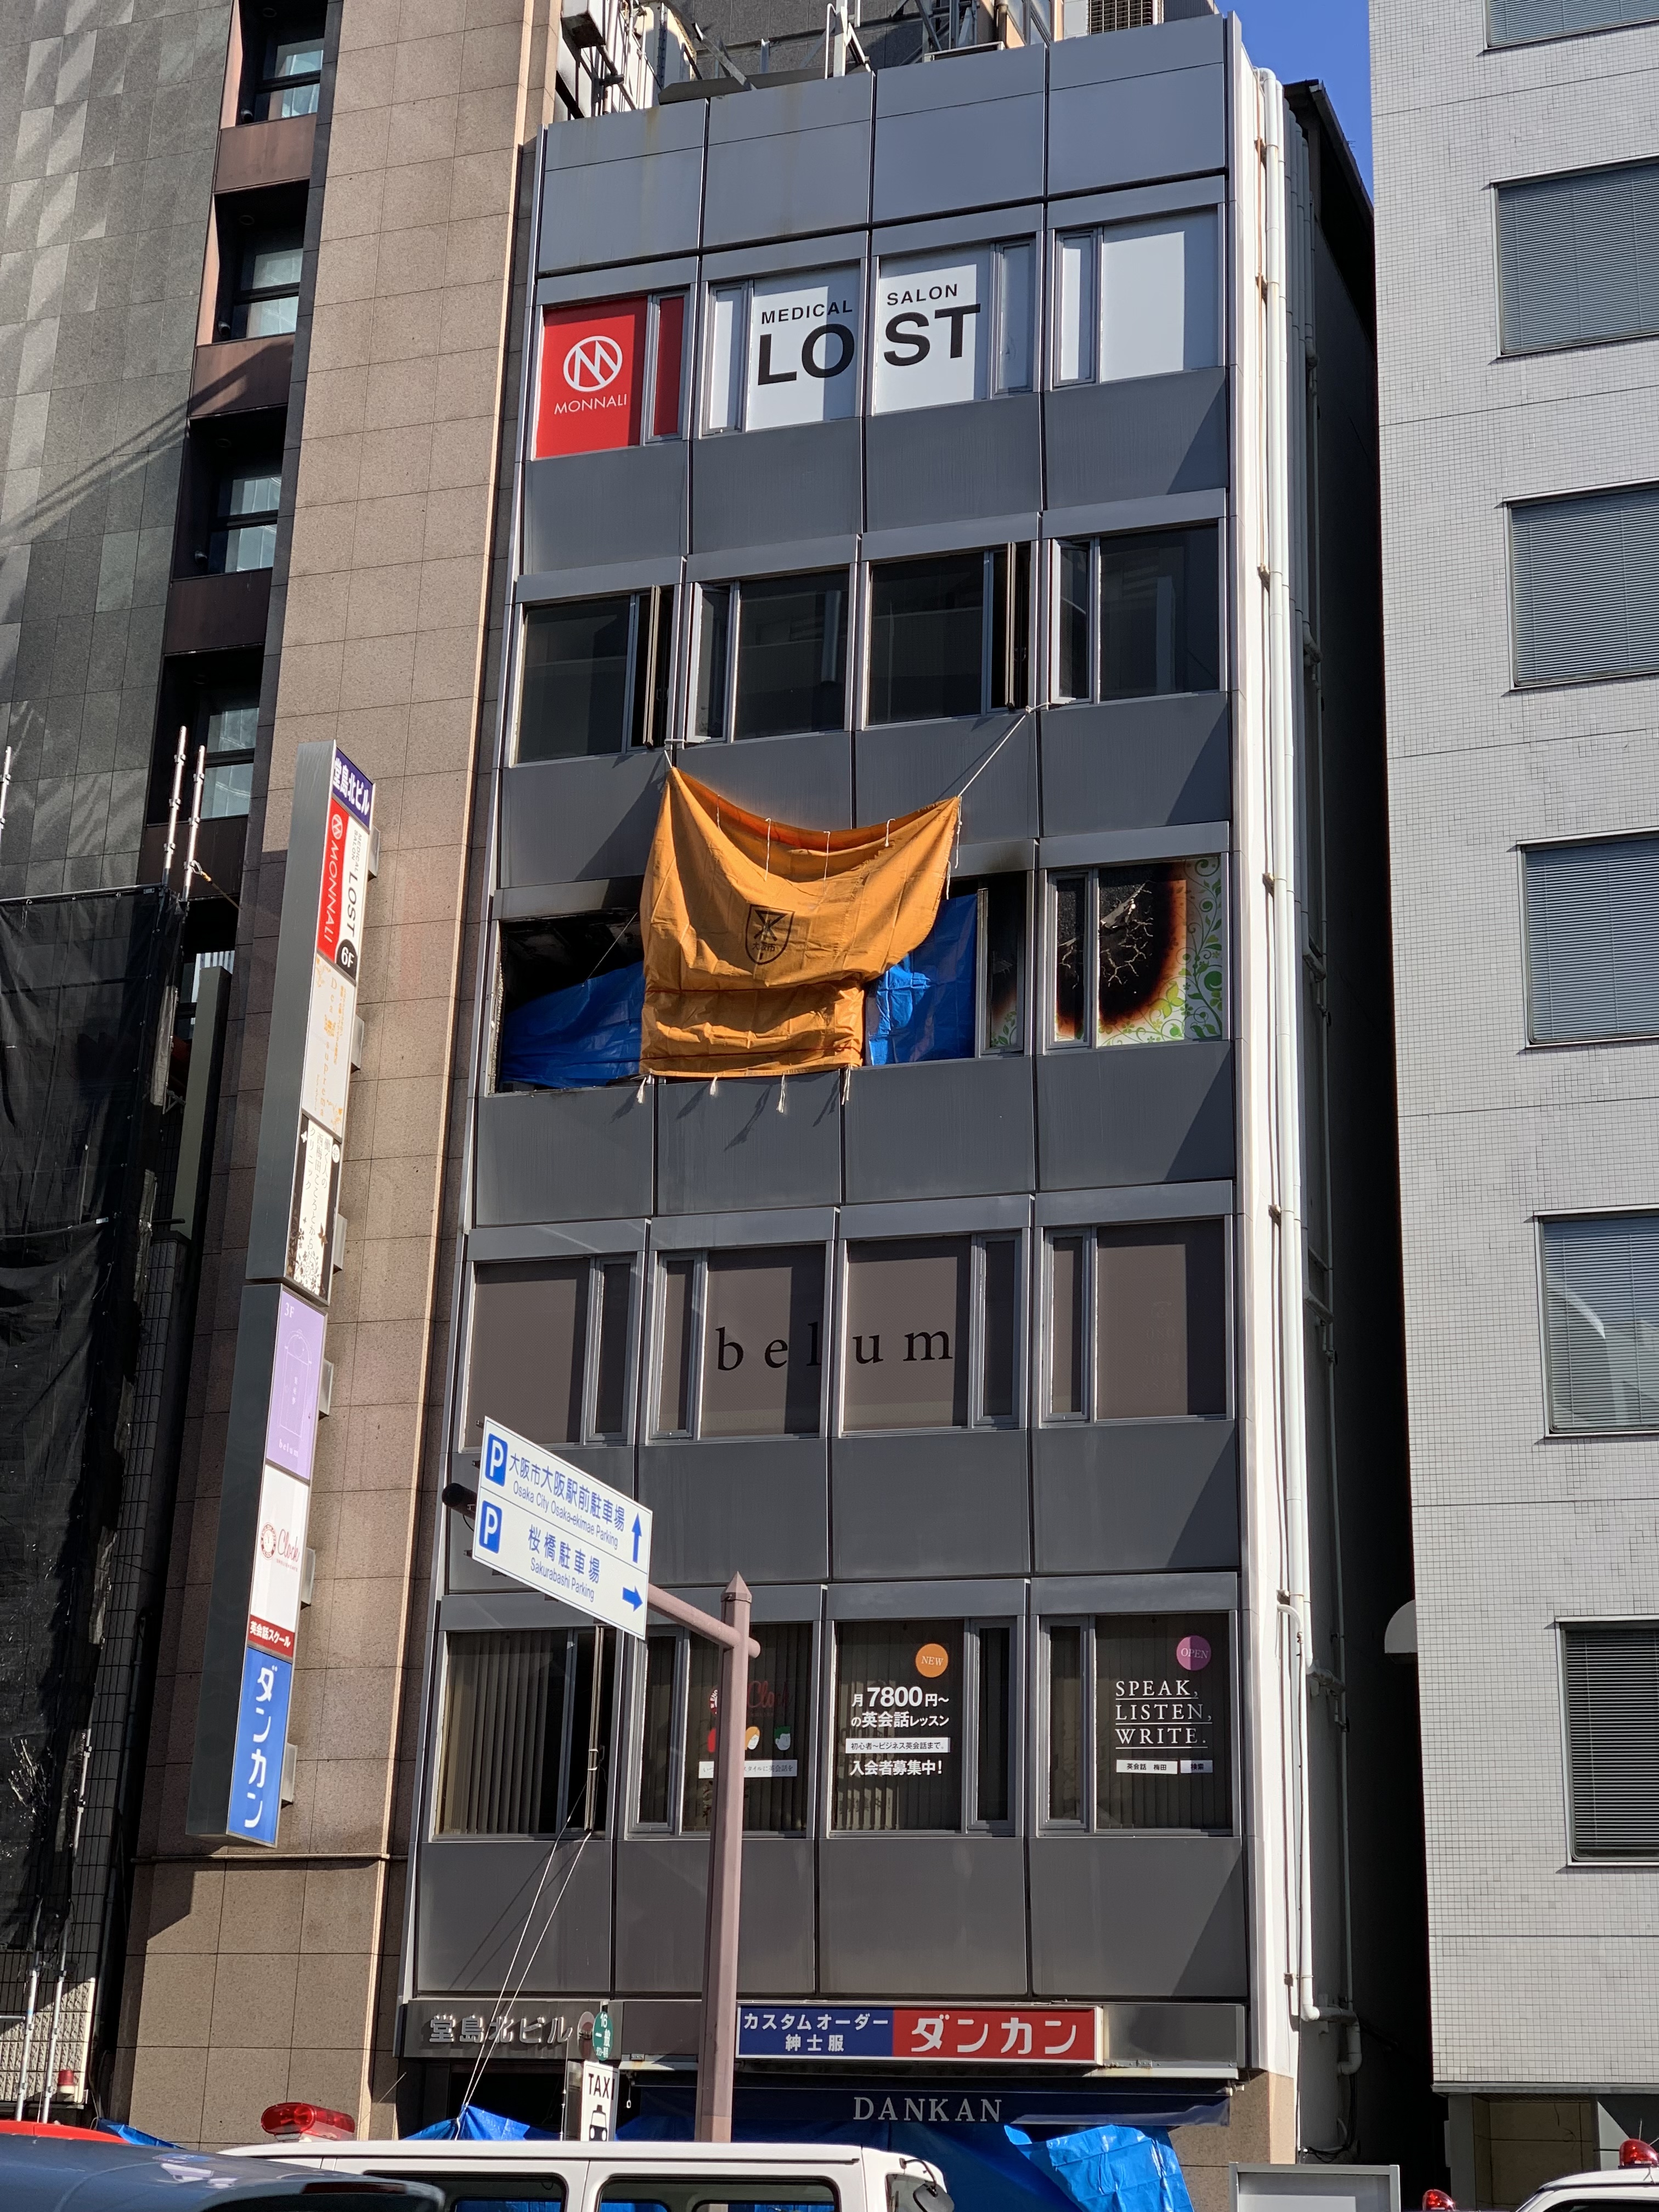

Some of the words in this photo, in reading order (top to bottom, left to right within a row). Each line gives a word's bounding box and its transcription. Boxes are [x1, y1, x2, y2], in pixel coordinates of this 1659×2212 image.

[761, 300, 853, 325] MEDICAL
[886, 283, 958, 306] SALON
[758, 303, 981, 386] LOST
[554, 393, 627, 415] MONNALI
[333, 757, 370, 815] 堂島北ビル
[351, 830, 359, 861] SALON
[354, 833, 362, 872] MEDICAL
[324, 840, 339, 943] MONNALI
[347, 871, 358, 937] LOST
[341, 946, 354, 968] 6F
[306, 1127, 315, 1190] クリニック
[284, 1302, 294, 1318] 3F
[715, 1321, 953, 1371] belum
[279, 1438, 298, 1458] belum
[490, 1438, 504, 1477] P
[509, 1453, 625, 1532] 大阪市大阪駅前駐車場
[484, 1505, 498, 1545] P
[514, 1480, 534, 1503] Osaka
[536, 1492, 549, 1514] City
[551, 1500, 595, 1536] Osaka-ekimae
[596, 1525, 618, 1550] Parking
[278, 1528, 300, 1562] Clock
[528, 1524, 600, 1584] 桜橋駐車場
[531, 1557, 570, 1589] Sakurabashi
[571, 1577, 595, 1603] Parking
[250, 1621, 291, 1648] 英会話スクール
[921, 1656, 944, 1667] NEW
[1181, 1647, 1209, 1660] OPEN
[1116, 1680, 1198, 1699] SPEAK,
[851, 1711, 950, 1728] の英会話レッスン
[1115, 1704, 1212, 1722] LISTEN,
[244, 1664, 278, 1829] ダンカン
[1115, 1728, 1207, 1745] WRITE.
[428, 2013, 573, 2045] 堂島北ビル
[600, 2013, 608, 2028] 16
[743, 2012, 889, 2031] カスタムオーダー
[911, 2013, 1076, 2055] ダンカン
[785, 2033, 845, 2052] 紳士服
[588, 2073, 615, 2101] TAXI
[853, 2096, 1002, 2123] DANKAN
